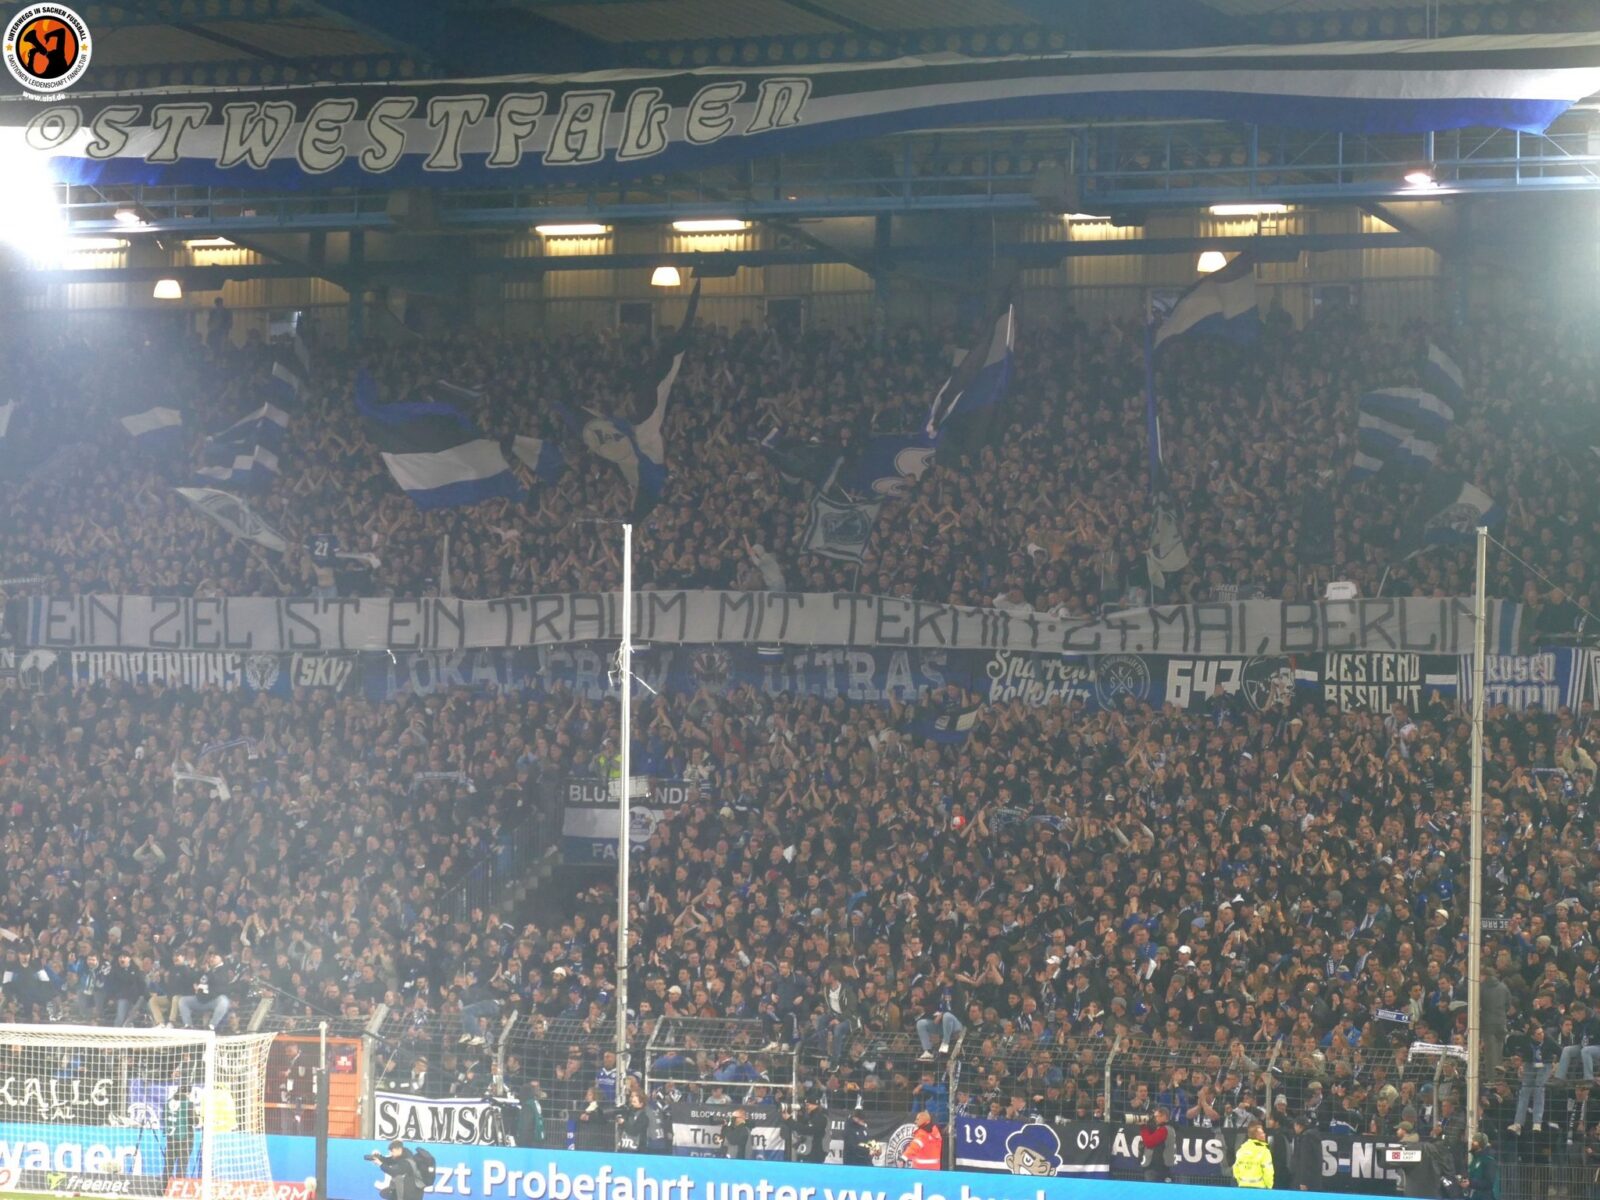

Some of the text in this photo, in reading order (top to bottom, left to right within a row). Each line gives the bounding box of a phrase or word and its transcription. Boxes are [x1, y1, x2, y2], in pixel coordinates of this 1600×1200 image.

[25, 77, 813, 176] OSTWESTFALEN
[46, 594, 122, 646] EIN
[150, 597, 252, 649] ZIEL
[277, 598, 361, 649] IST
[387, 597, 464, 649] EIN
[488, 592, 687, 647] TRAUM
[718, 592, 804, 640] MIT
[1280, 598, 1494, 652] BERLIN
[1165, 659, 1243, 709] 647
[1324, 653, 1421, 682] WESTEND
[965, 1124, 988, 1145] 19
[1076, 1129, 1100, 1150] 05
[483, 1159, 695, 1200] Probefahrt
